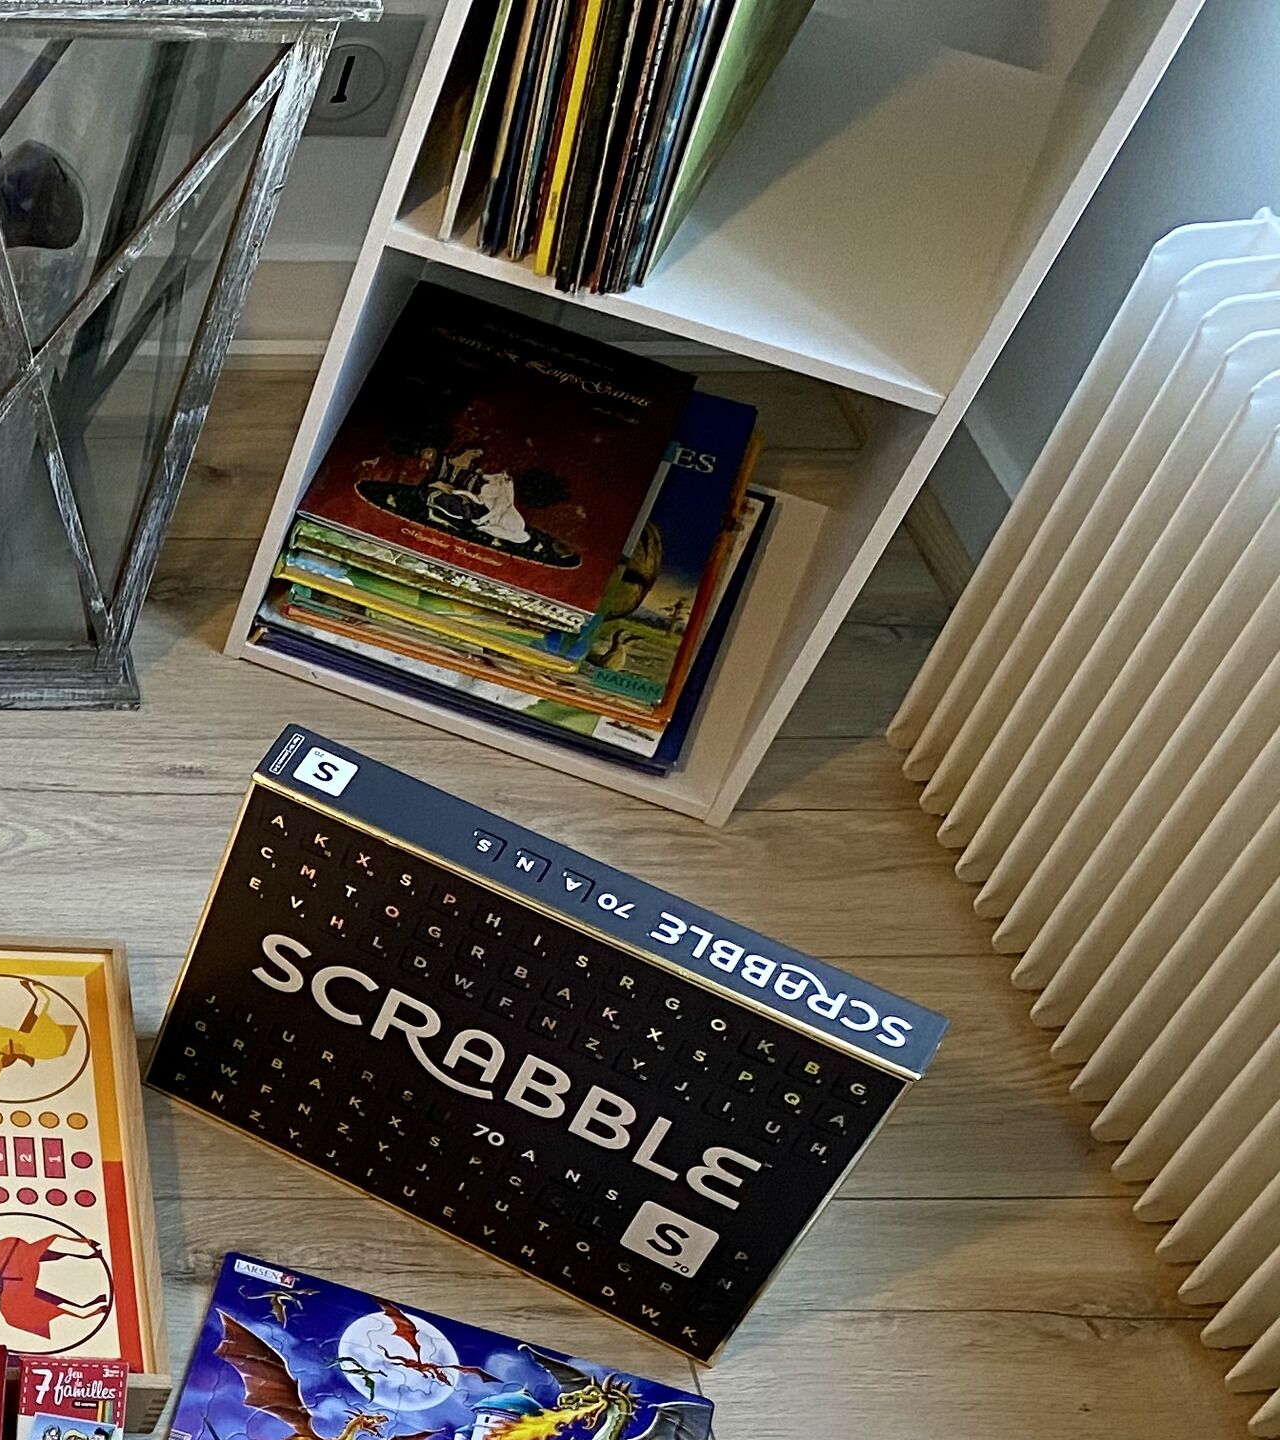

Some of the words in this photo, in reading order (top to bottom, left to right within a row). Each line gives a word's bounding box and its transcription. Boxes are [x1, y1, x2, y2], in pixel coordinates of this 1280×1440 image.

[596, 670, 662, 697] NATHAN
[312, 761, 340, 782] S
[597, 893, 636, 919] 70
[646, 911, 913, 1048] SCRABBLE
[251, 933, 762, 1210] SCRABBLE
[472, 1123, 505, 1147] 70
[19, 1153, 33, 1163] 2
[48, 1155, 62, 1164] 1
[646, 1223, 690, 1257] S
[236, 1261, 279, 1280] LARSEN
[672, 1261, 690, 1274] 70
[31, 1368, 53, 1405] 7
[63, 1367, 84, 1384] Jeu
[53, 1371, 117, 1406] familles
